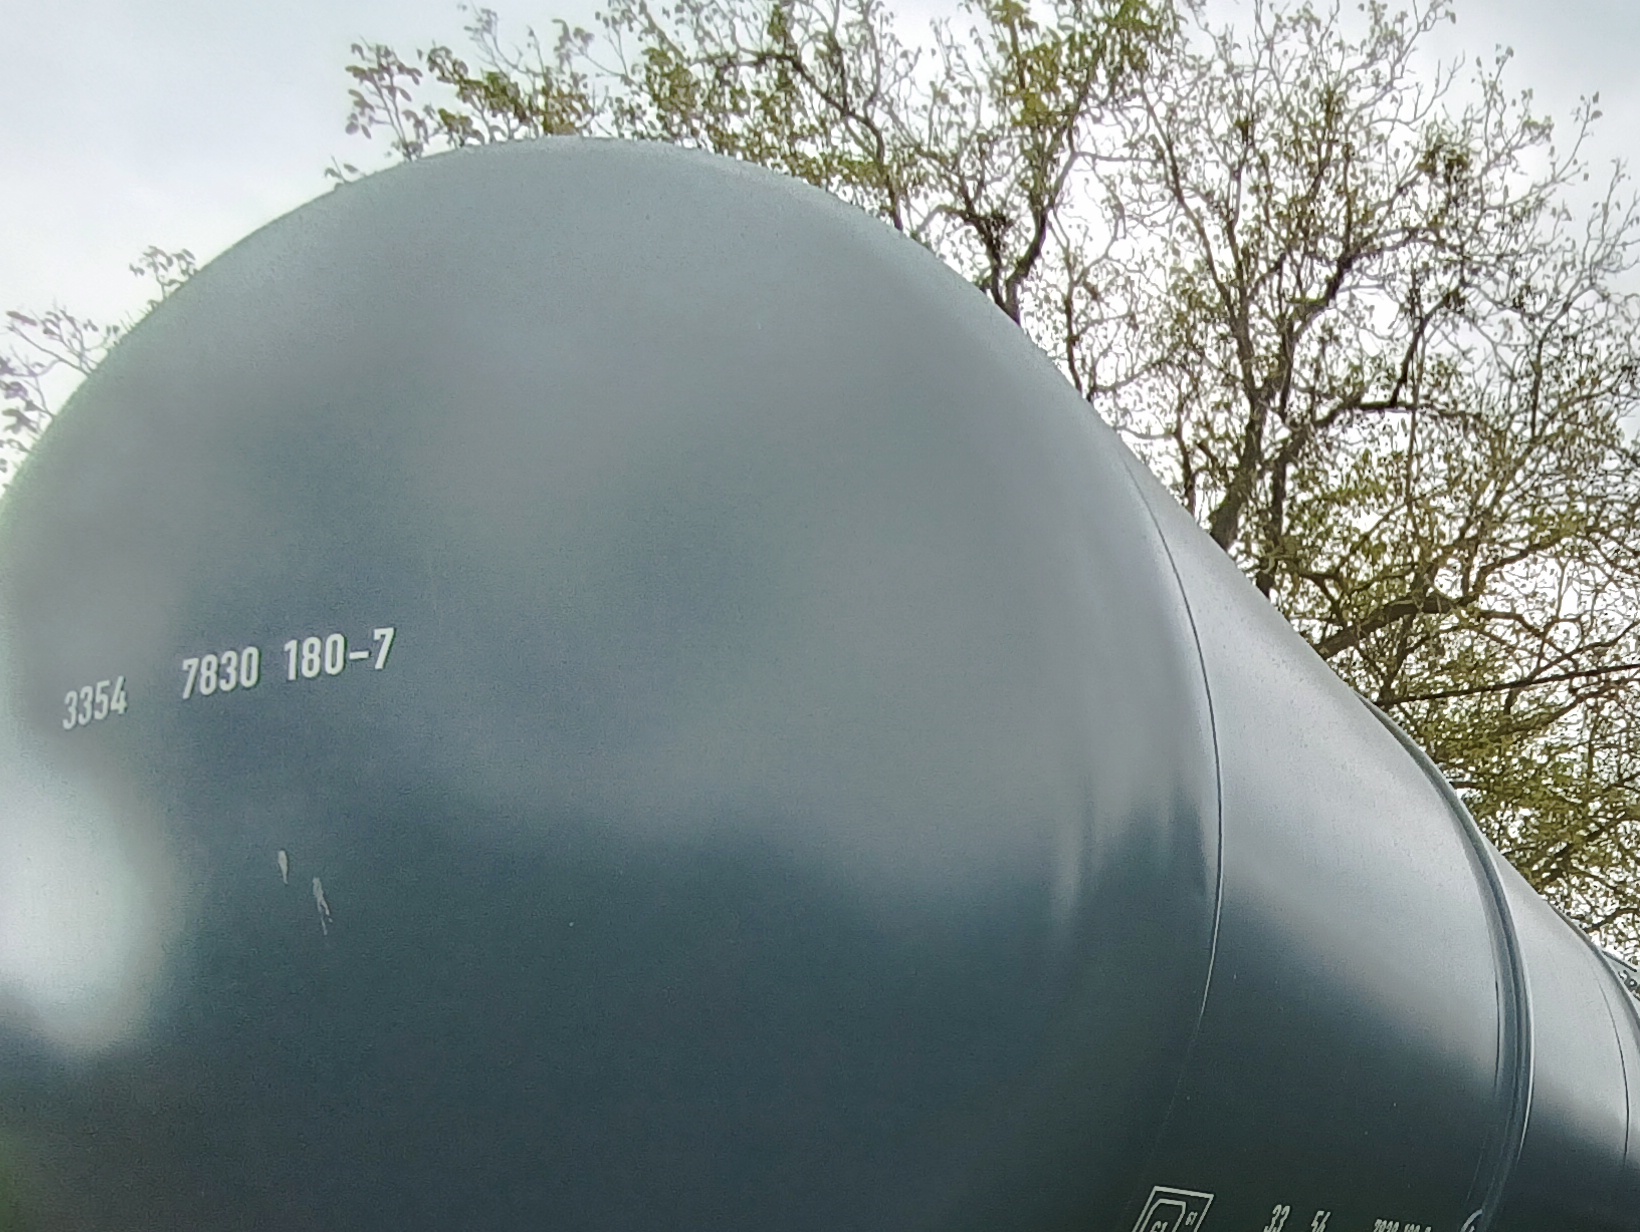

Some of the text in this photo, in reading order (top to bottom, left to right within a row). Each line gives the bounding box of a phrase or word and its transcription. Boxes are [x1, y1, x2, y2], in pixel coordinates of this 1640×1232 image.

[62, 626, 397, 731] 3354 7830 180-7
